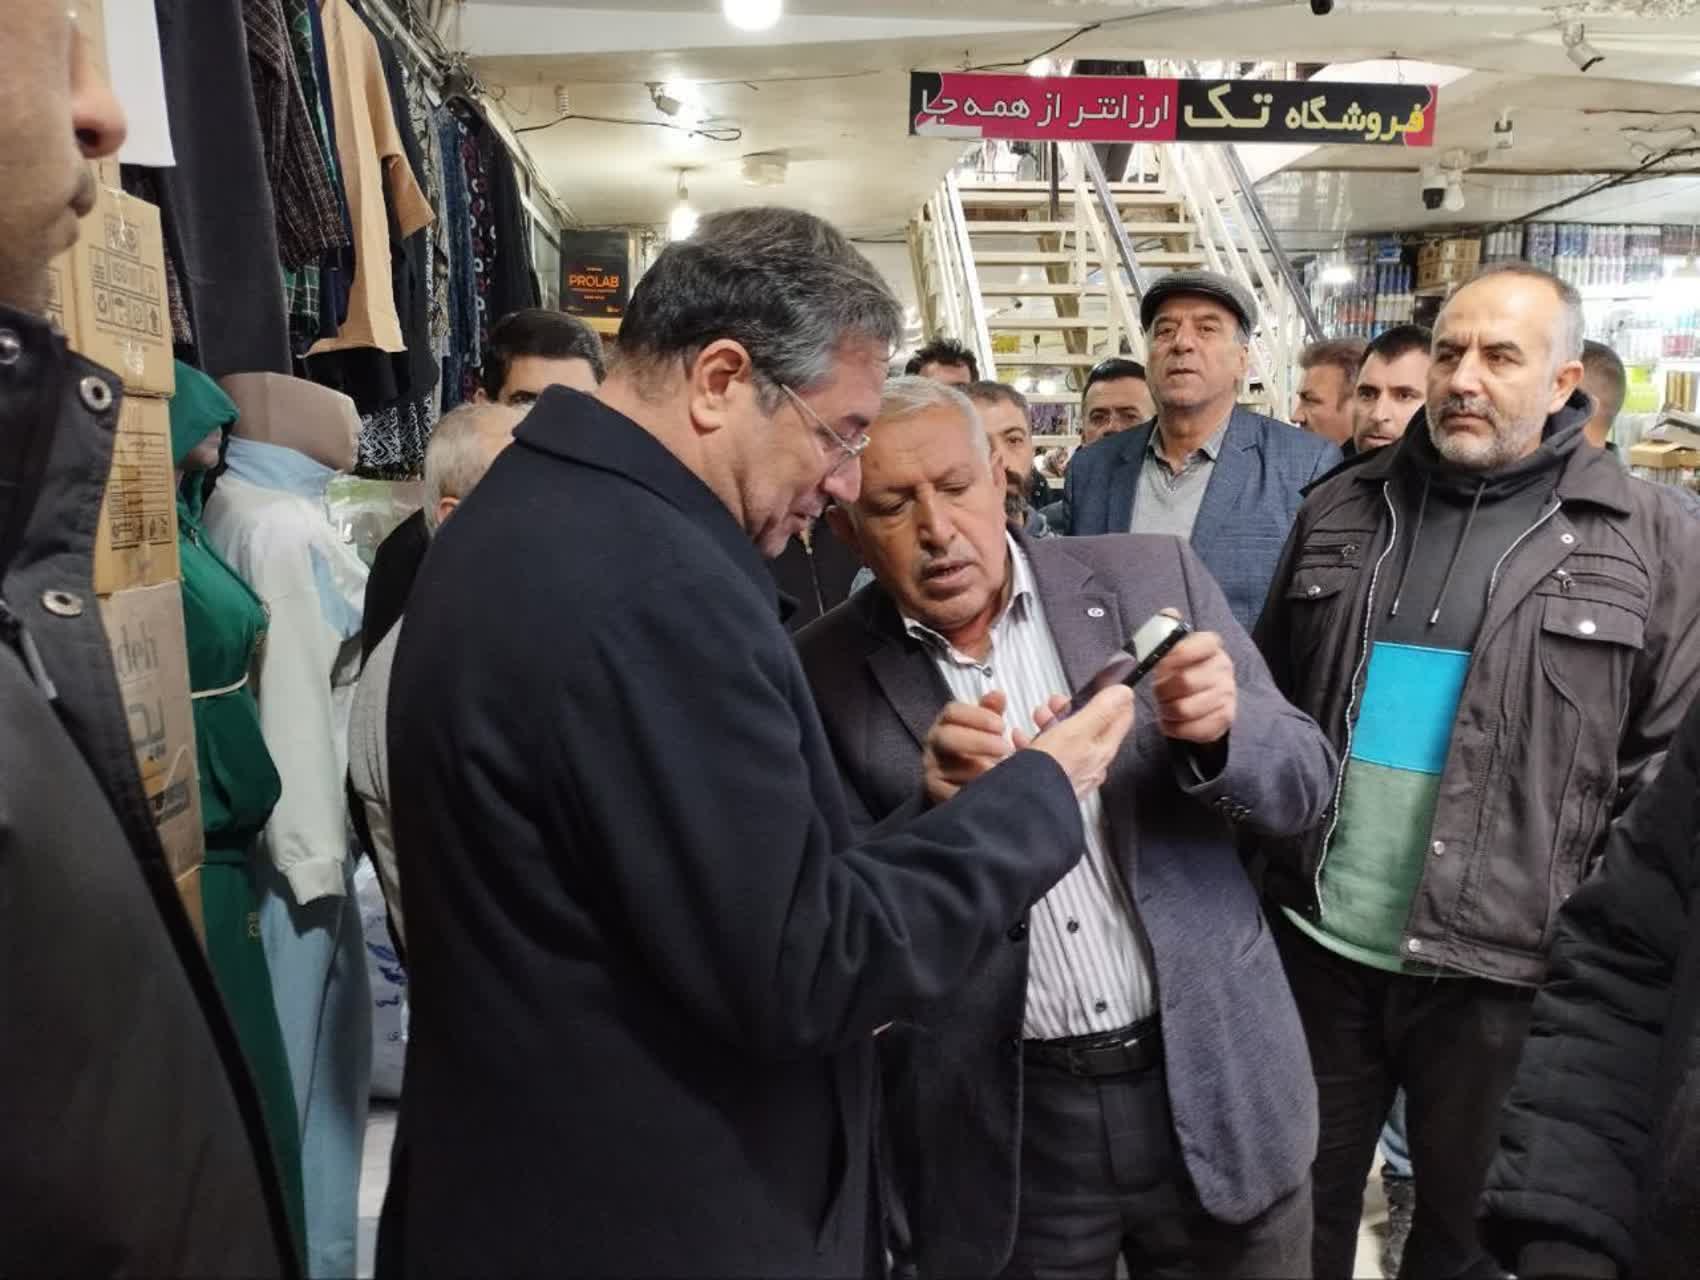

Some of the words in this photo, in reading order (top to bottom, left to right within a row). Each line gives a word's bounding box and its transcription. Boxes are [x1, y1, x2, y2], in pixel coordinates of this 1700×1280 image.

[922, 89, 959, 124] جا
[963, 96, 1031, 119] همه
[1036, 92, 1061, 127] از
[1068, 94, 1169, 128] ارزانتر
[1184, 83, 1274, 128] تک
[1285, 95, 1424, 141] فروشگاه
[568, 274, 620, 288] PROLAB
